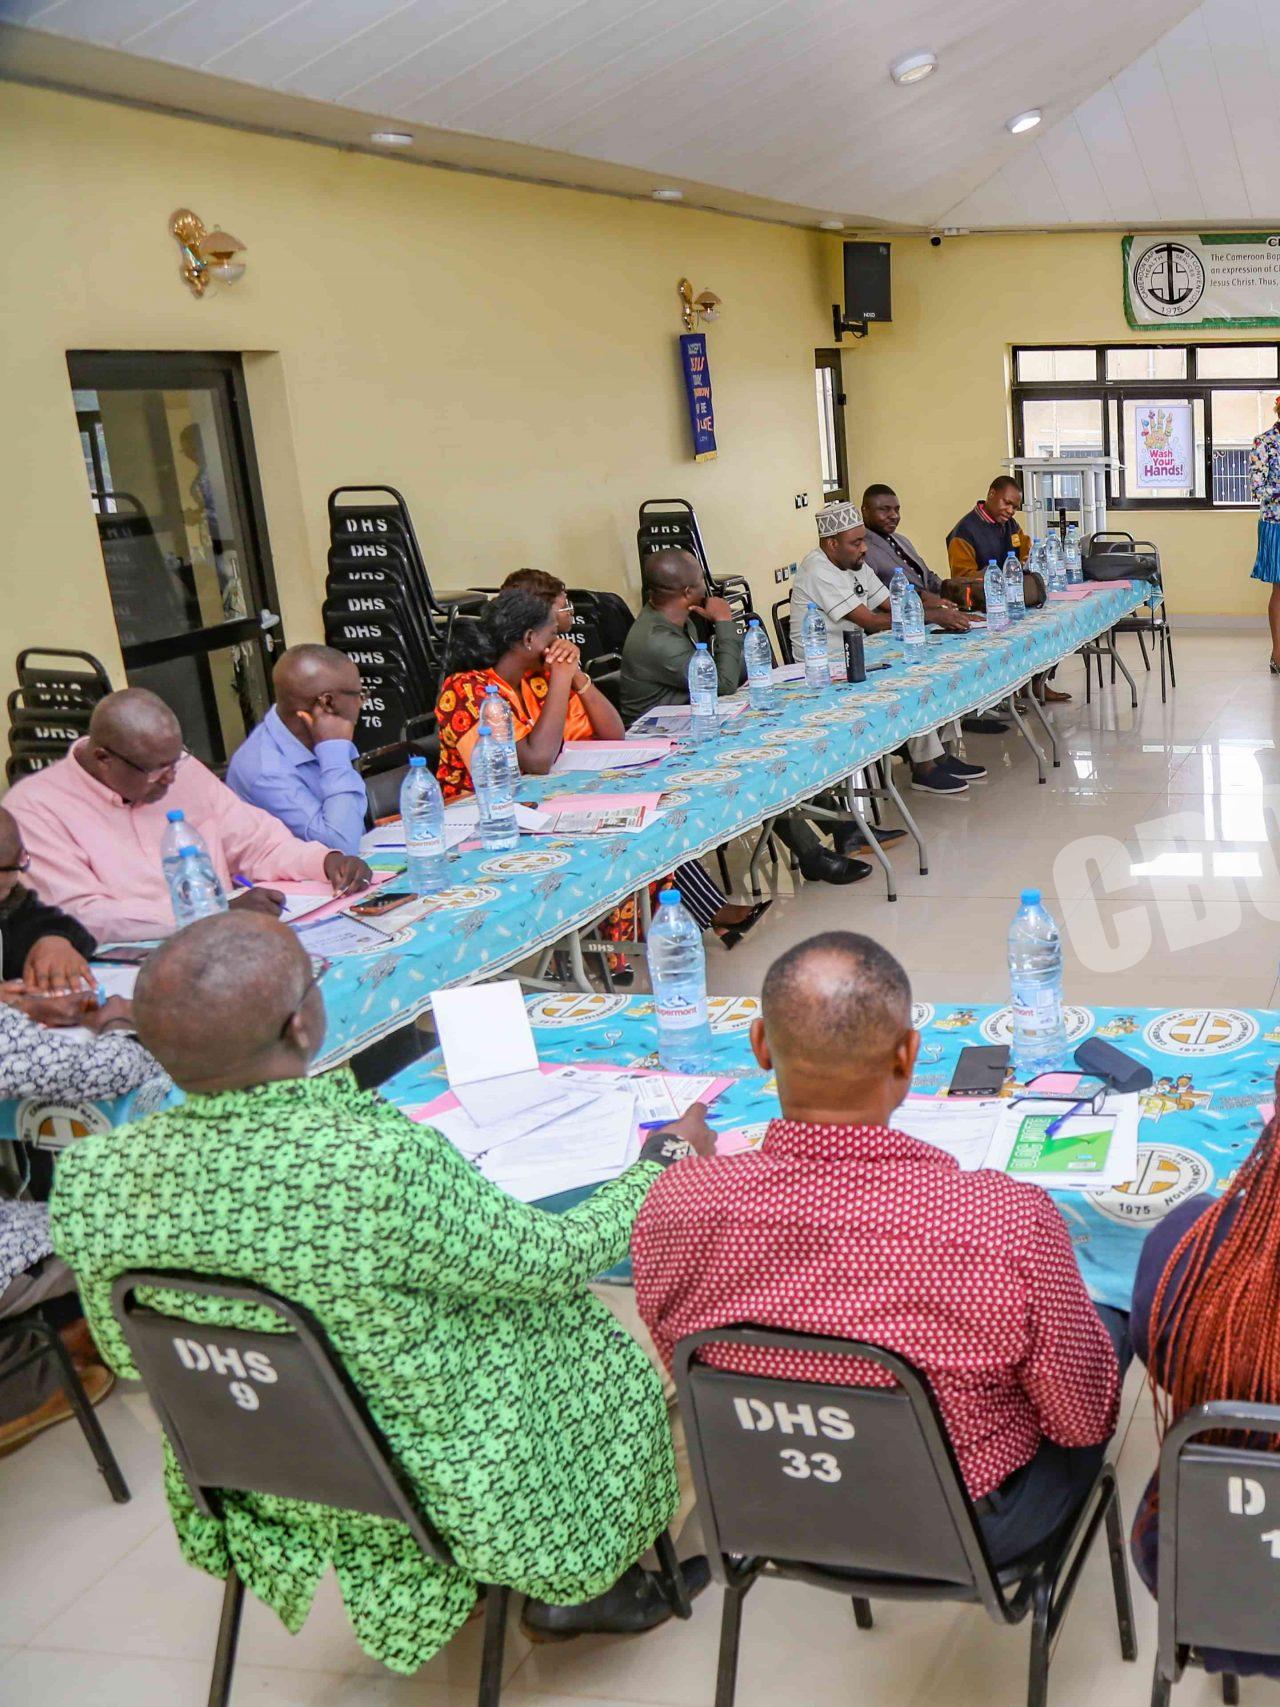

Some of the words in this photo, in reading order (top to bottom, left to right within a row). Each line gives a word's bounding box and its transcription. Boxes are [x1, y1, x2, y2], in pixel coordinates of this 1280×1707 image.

[1211, 253, 1224, 262] The
[1226, 252, 1265, 262] Cameroon
[1222, 266, 1262, 275] expression
[1149, 449, 1173, 458] Wash
[1153, 458, 1174, 467] Your
[1144, 464, 1184, 477] Hands!
[346, 519, 388, 532] DHS
[350, 544, 388, 557] DHS
[348, 598, 386, 611] DHS
[343, 625, 382, 638] DHS
[361, 715, 382, 728] 76
[588, 943, 615, 952] DHS
[1118, 1202, 1151, 1216] 1975
[172, 1337, 278, 1384] DHS
[229, 1380, 260, 1411] 9
[733, 1397, 856, 1441] DHS
[779, 1448, 842, 1483] 33
